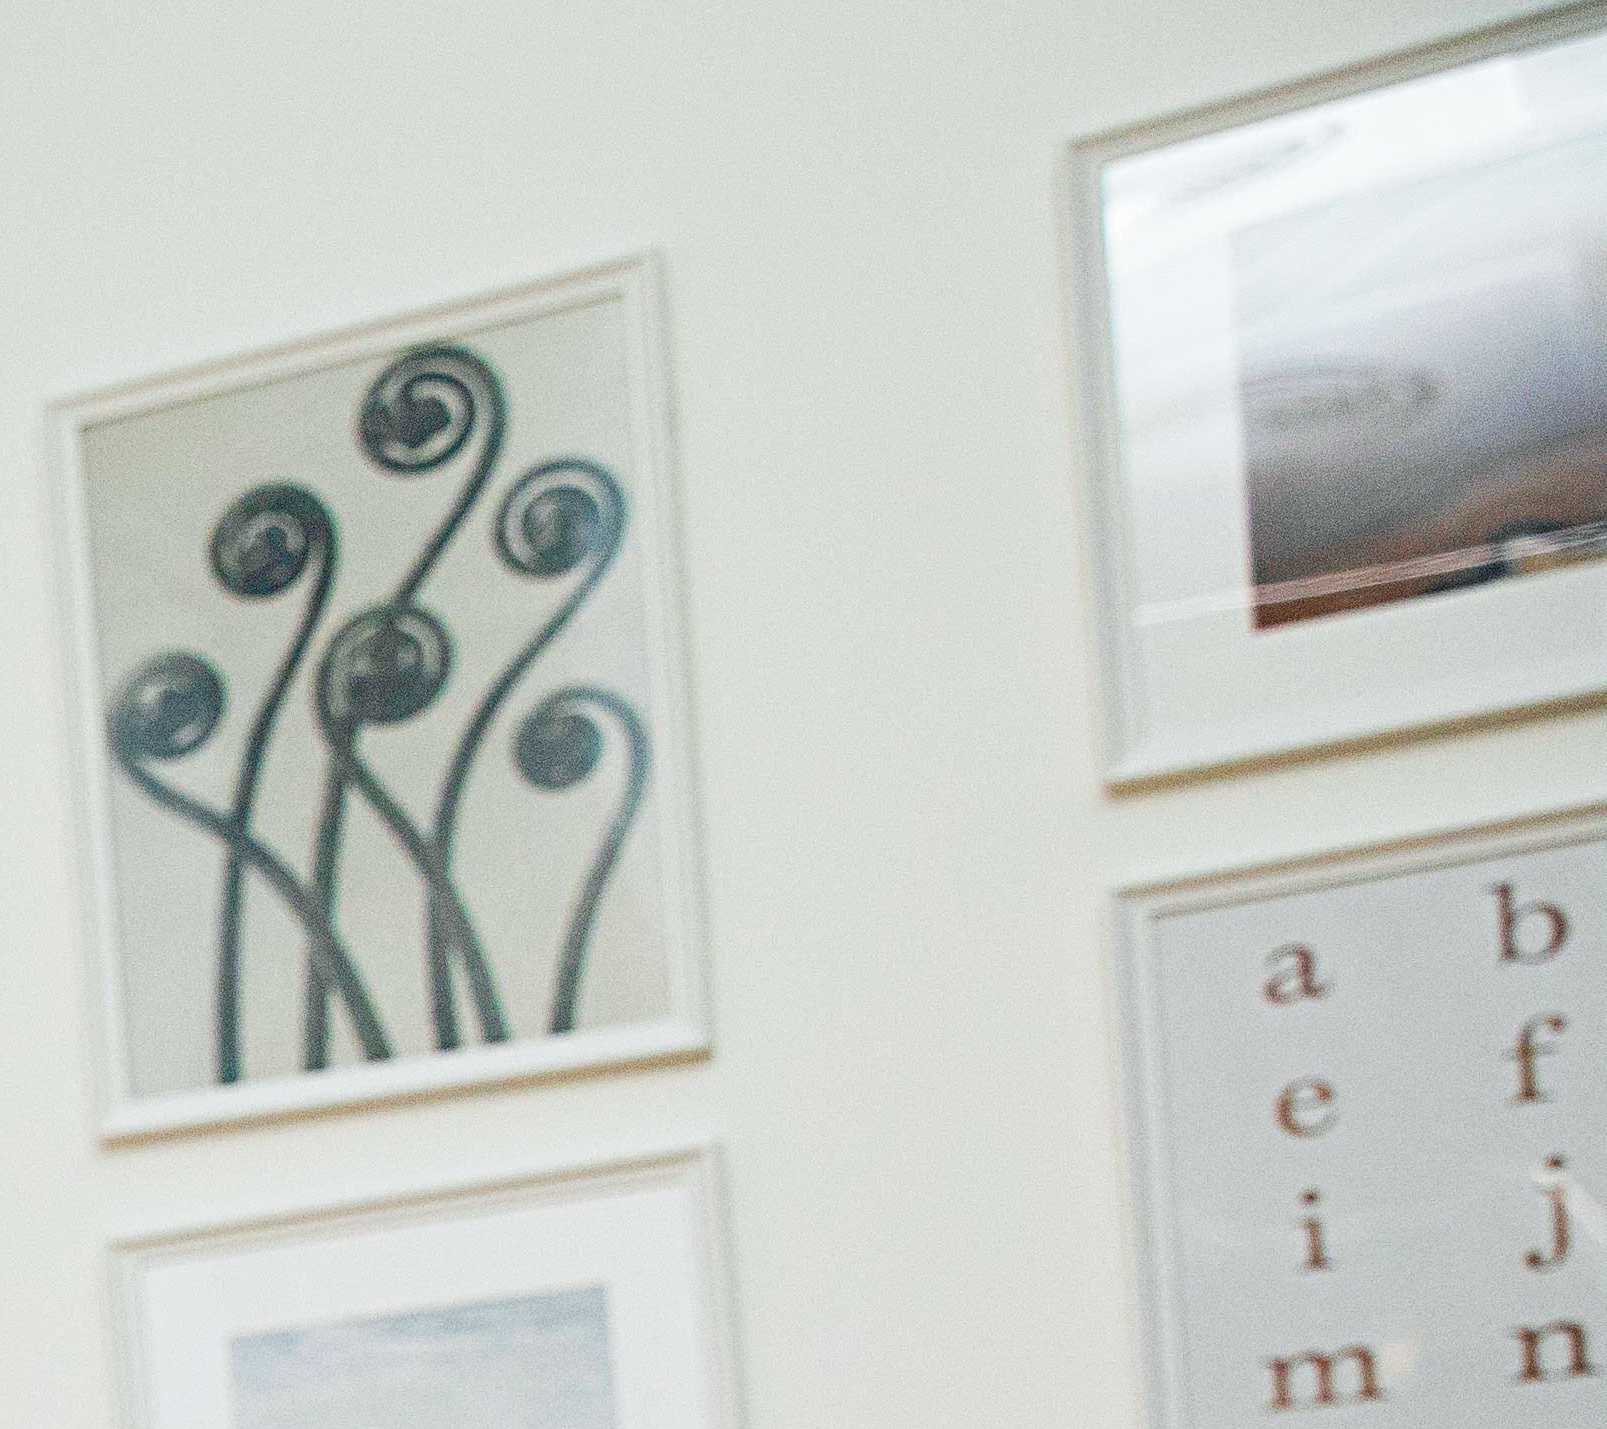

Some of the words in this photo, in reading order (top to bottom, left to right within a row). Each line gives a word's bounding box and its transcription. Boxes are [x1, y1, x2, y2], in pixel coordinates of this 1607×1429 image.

[1261, 939, 1330, 1004] a
[1489, 880, 1571, 965] b
[1272, 1073, 1336, 1138] e
[1508, 1013, 1568, 1103] f
[1296, 1189, 1334, 1271] i
[1523, 1152, 1573, 1271] j
[1264, 1343, 1384, 1412] m
[1513, 1319, 1596, 1383] n
